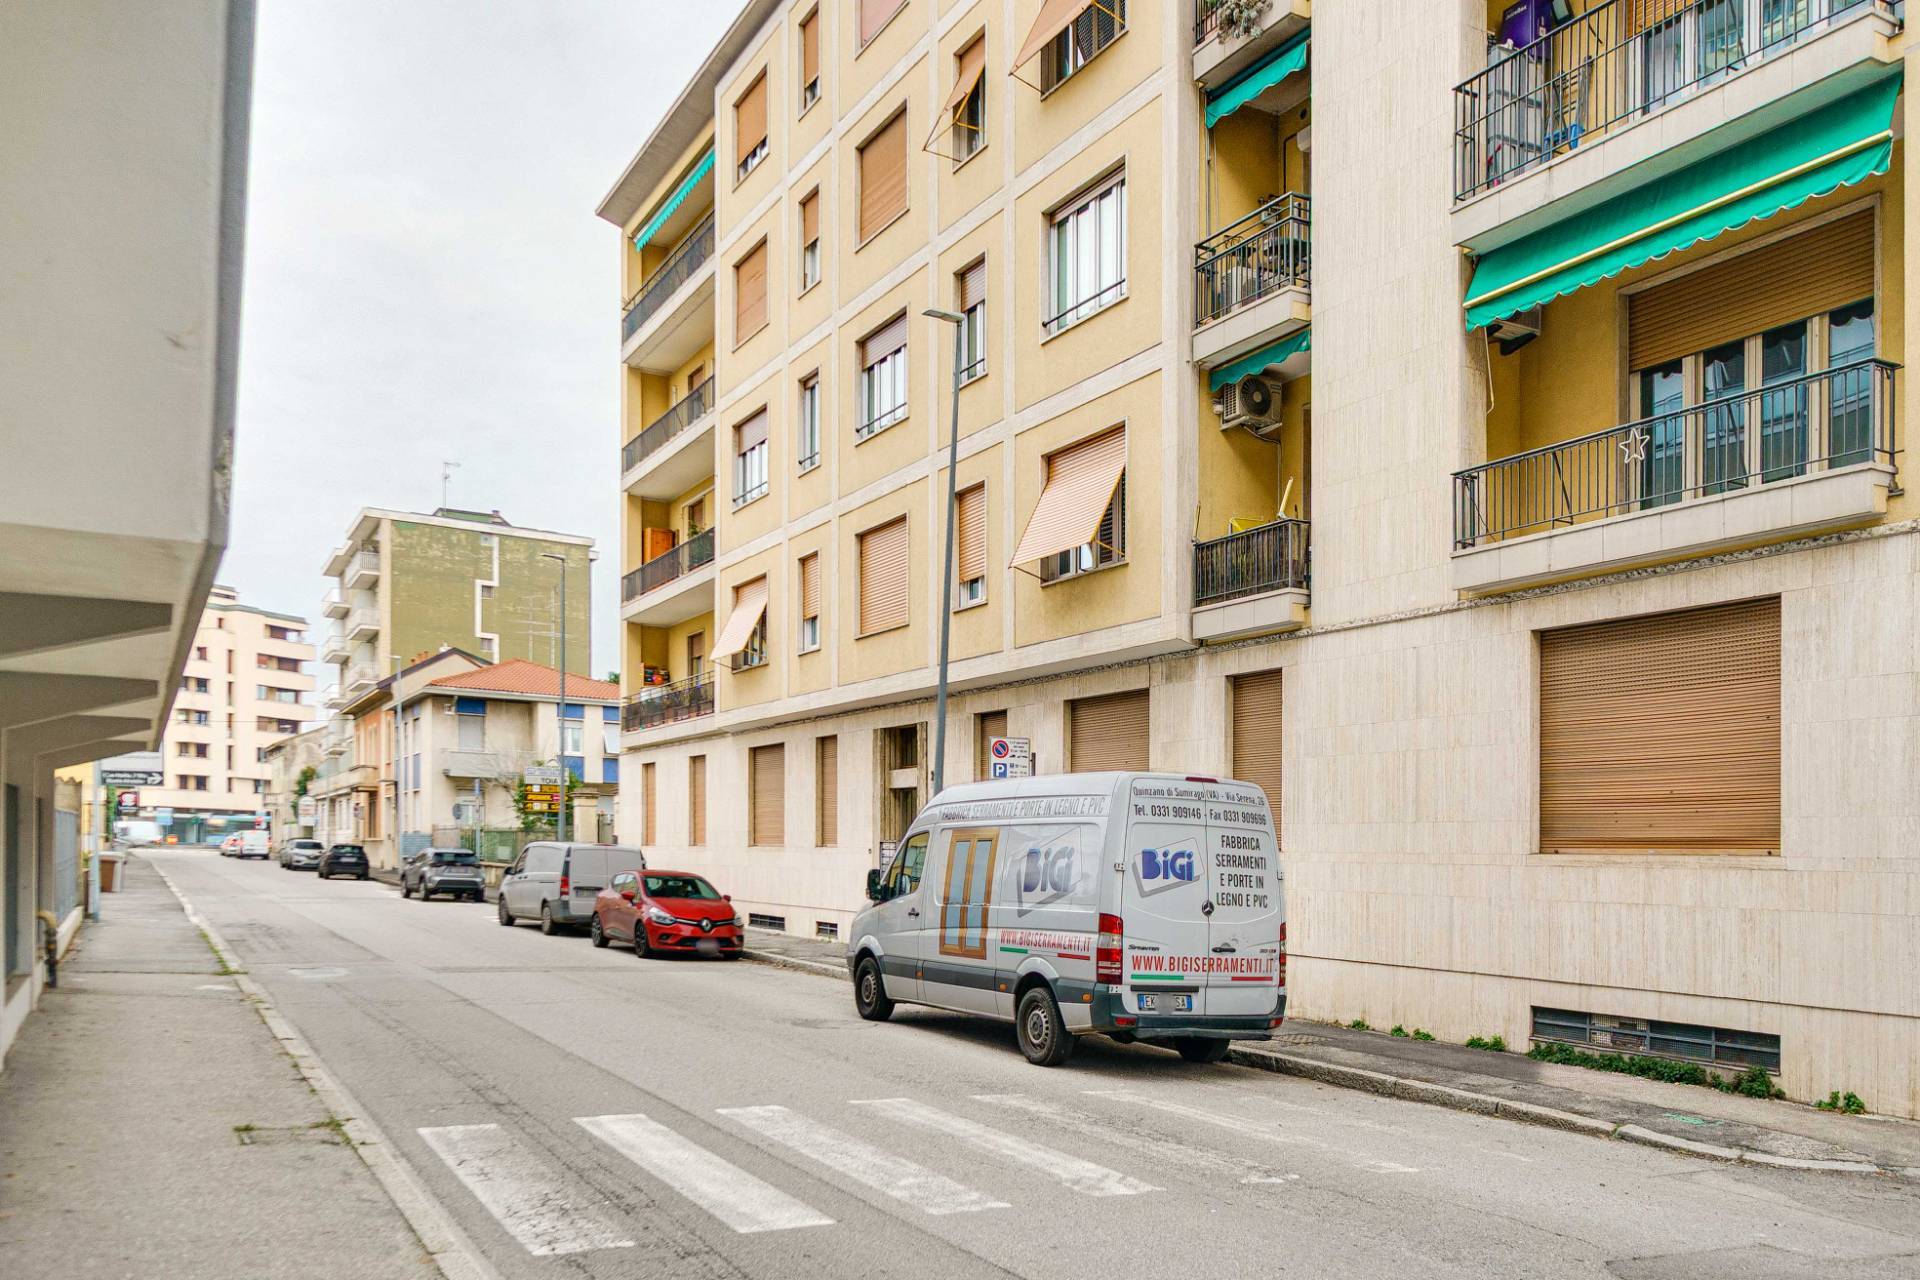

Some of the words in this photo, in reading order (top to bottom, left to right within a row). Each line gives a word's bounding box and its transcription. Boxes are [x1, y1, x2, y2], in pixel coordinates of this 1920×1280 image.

[995, 764, 1005, 777] P
[1133, 786, 1165, 796] Quinzano
[1167, 788, 1173, 797] di
[1174, 788, 1205, 800] Sumirago
[1205, 790, 1219, 800] (VA)
[1226, 792, 1235, 801] Via
[972, 801, 1013, 818] SERRAMENTI
[1014, 801, 1021, 817] E
[1021, 800, 1042, 816] PORTE
[1043, 799, 1054, 815] IN
[1054, 798, 1080, 815] LEGNO
[1080, 797, 1087, 814] E
[1087, 797, 1107, 814] PVC
[1134, 804, 1148, 816] Tel.
[1151, 805, 1169, 818] 0331
[1172, 806, 1202, 819] 909146
[1209, 809, 1221, 821] Fax
[1223, 810, 1239, 823] 0331
[1221, 834, 1260, 851] FABBRICA
[1215, 853, 1267, 870] SERRAMENTI
[1220, 874, 1225, 886] E
[1227, 874, 1253, 889] PORTE
[1256, 876, 1264, 889] IN
[1216, 892, 1243, 907] LEGNO
[1246, 894, 1251, 907] E
[1253, 894, 1268, 908] PVC
[1000, 929, 1091, 952] WWW.BIGISERRAMENTI.IT
[1132, 955, 1274, 973] WWW.BIGISERRAMENTI.IT
